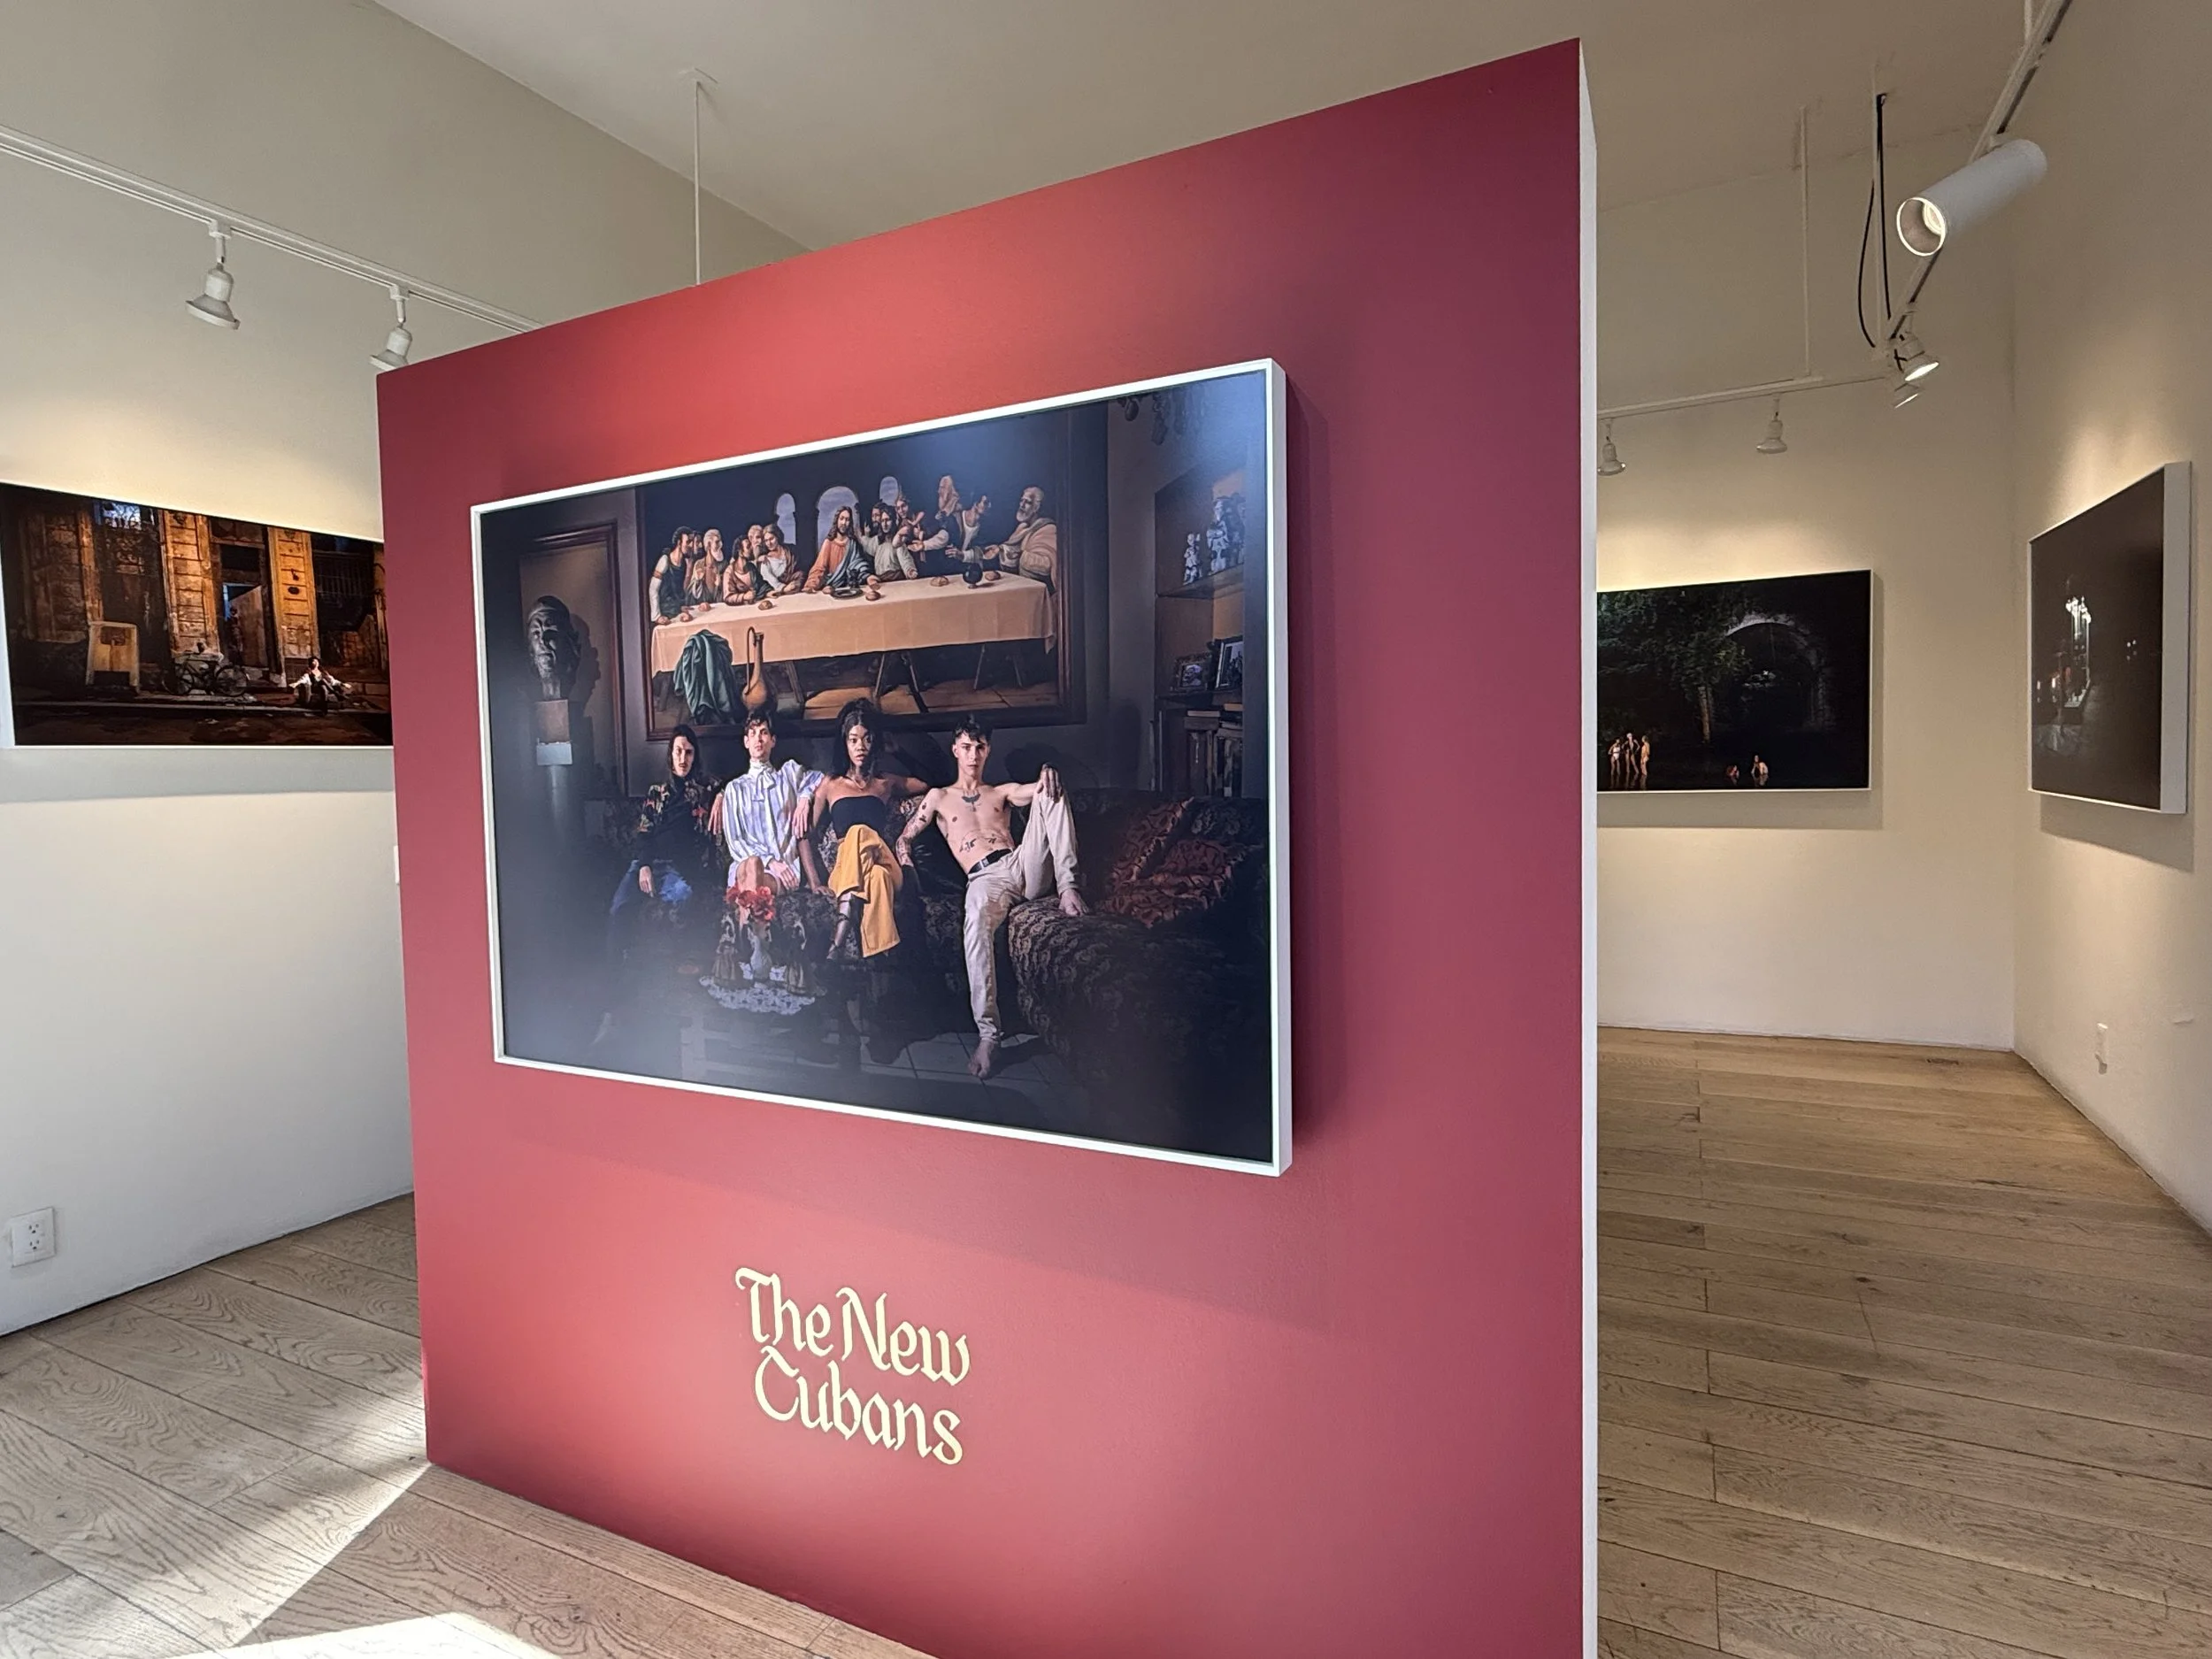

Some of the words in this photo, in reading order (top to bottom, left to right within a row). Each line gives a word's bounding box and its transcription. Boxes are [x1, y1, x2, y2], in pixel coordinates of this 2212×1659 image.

[734, 1266, 834, 1358] The
[835, 1286, 971, 1386] New
[753, 1344, 964, 1465] Cubans
